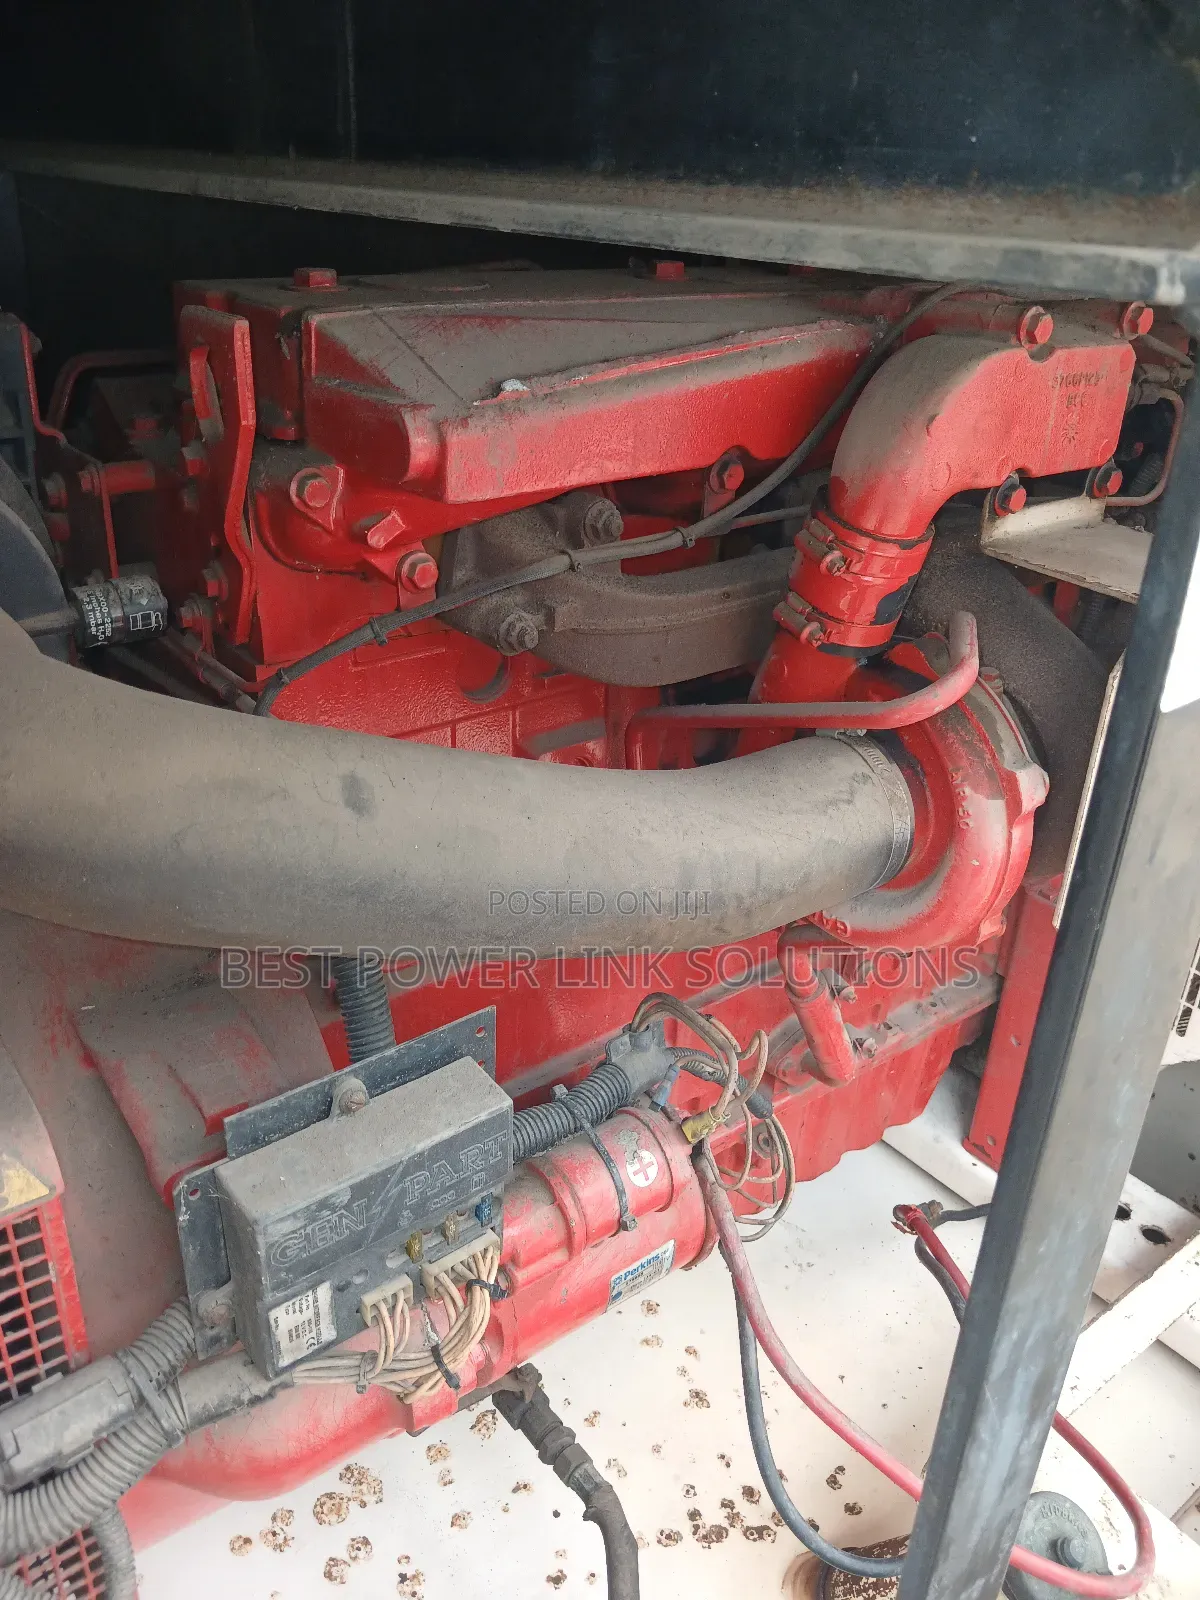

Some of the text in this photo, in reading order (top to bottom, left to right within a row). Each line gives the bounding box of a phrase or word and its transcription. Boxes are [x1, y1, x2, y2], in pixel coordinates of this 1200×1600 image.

[89, 595, 103, 624] inches
[88, 612, 97, 636] mbar
[270, 1129, 508, 1267] GEN PART
[623, 1253, 661, 1281] Perkins
